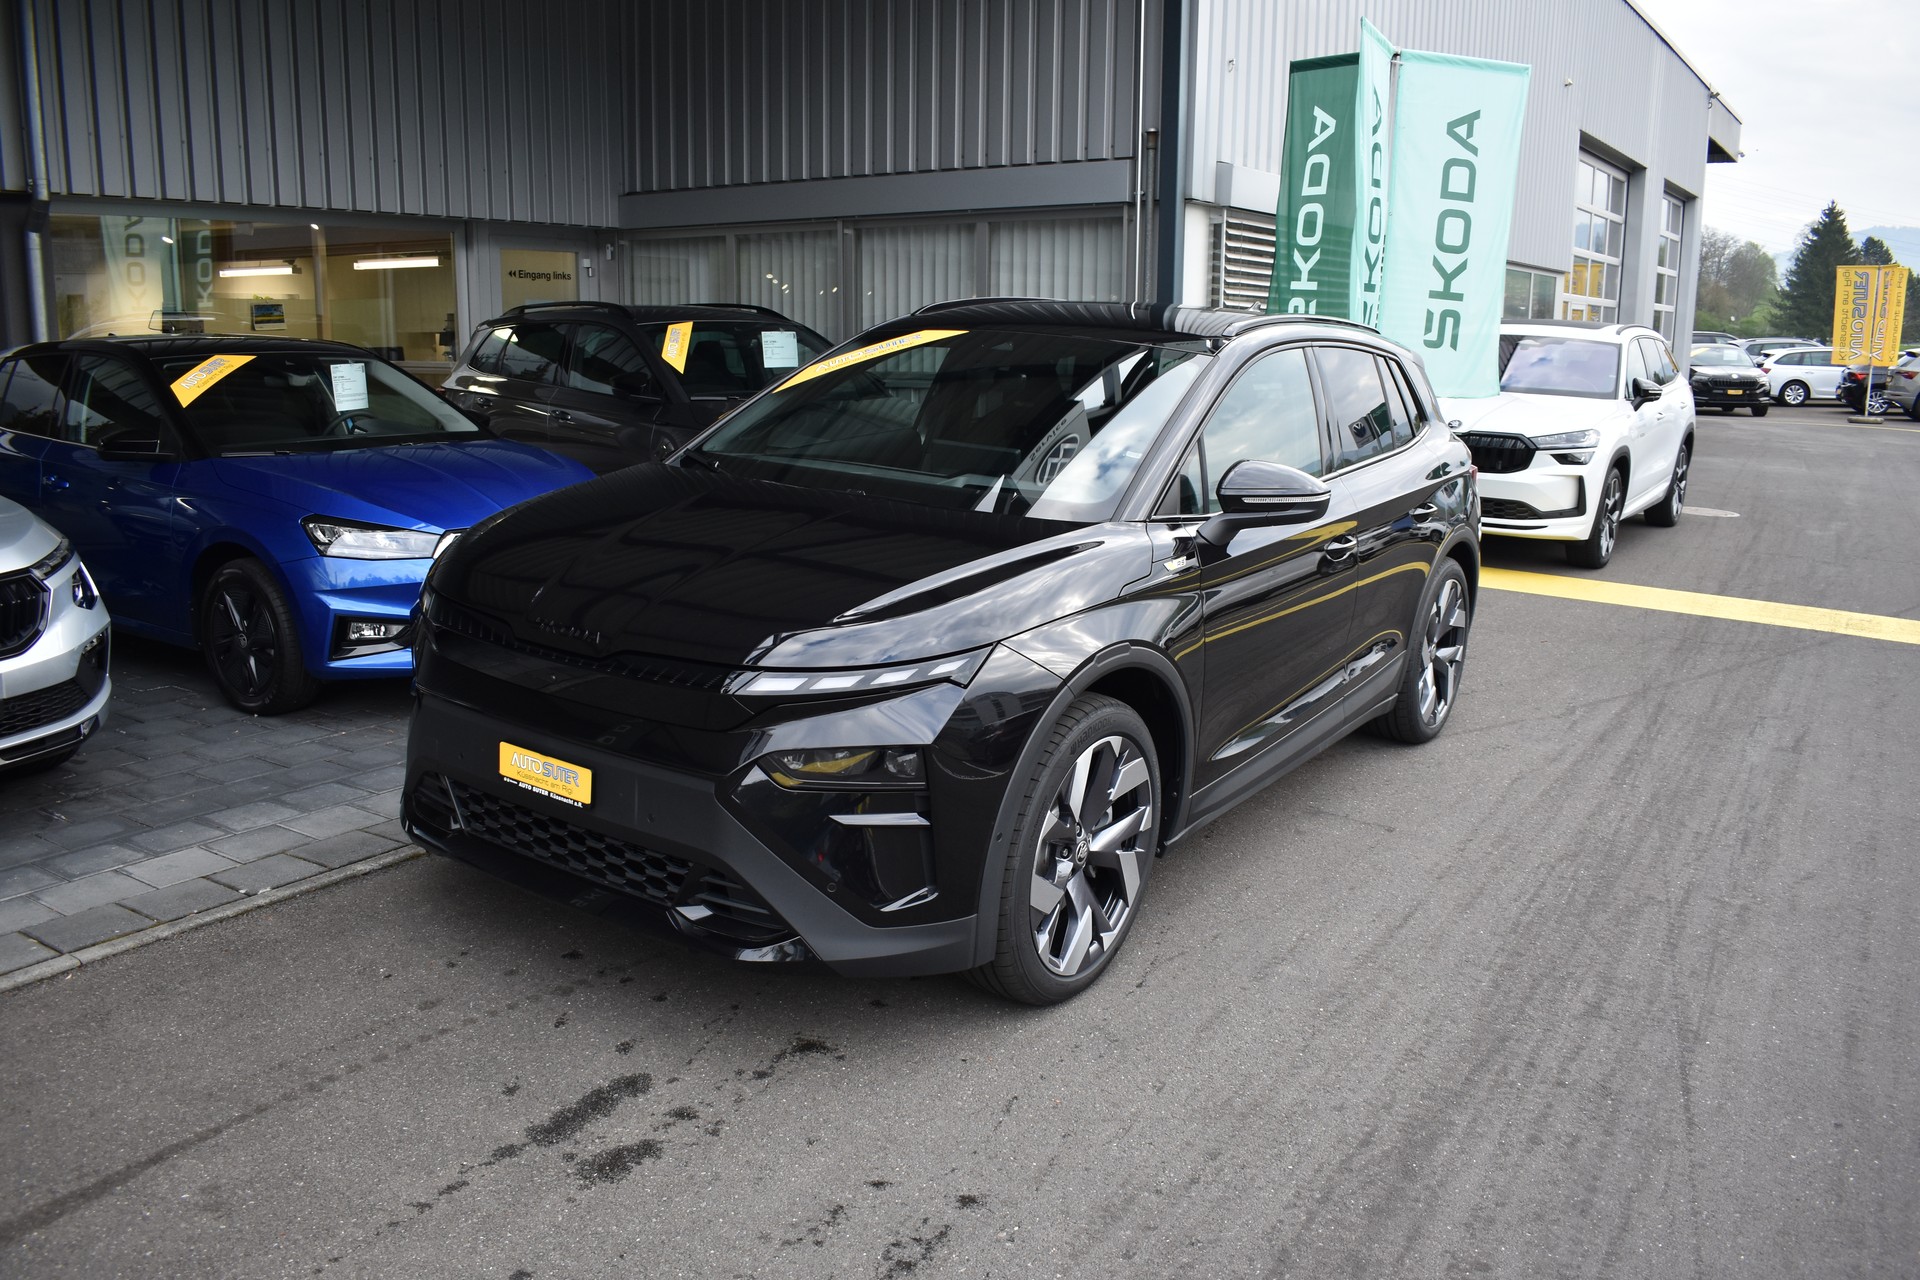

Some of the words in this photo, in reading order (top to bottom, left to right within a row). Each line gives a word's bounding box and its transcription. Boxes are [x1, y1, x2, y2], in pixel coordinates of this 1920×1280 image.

[518, 269, 551, 281] Eingang
[553, 271, 572, 280] links
[519, 781, 532, 790] AUTO
[532, 786, 549, 796] SUTER
